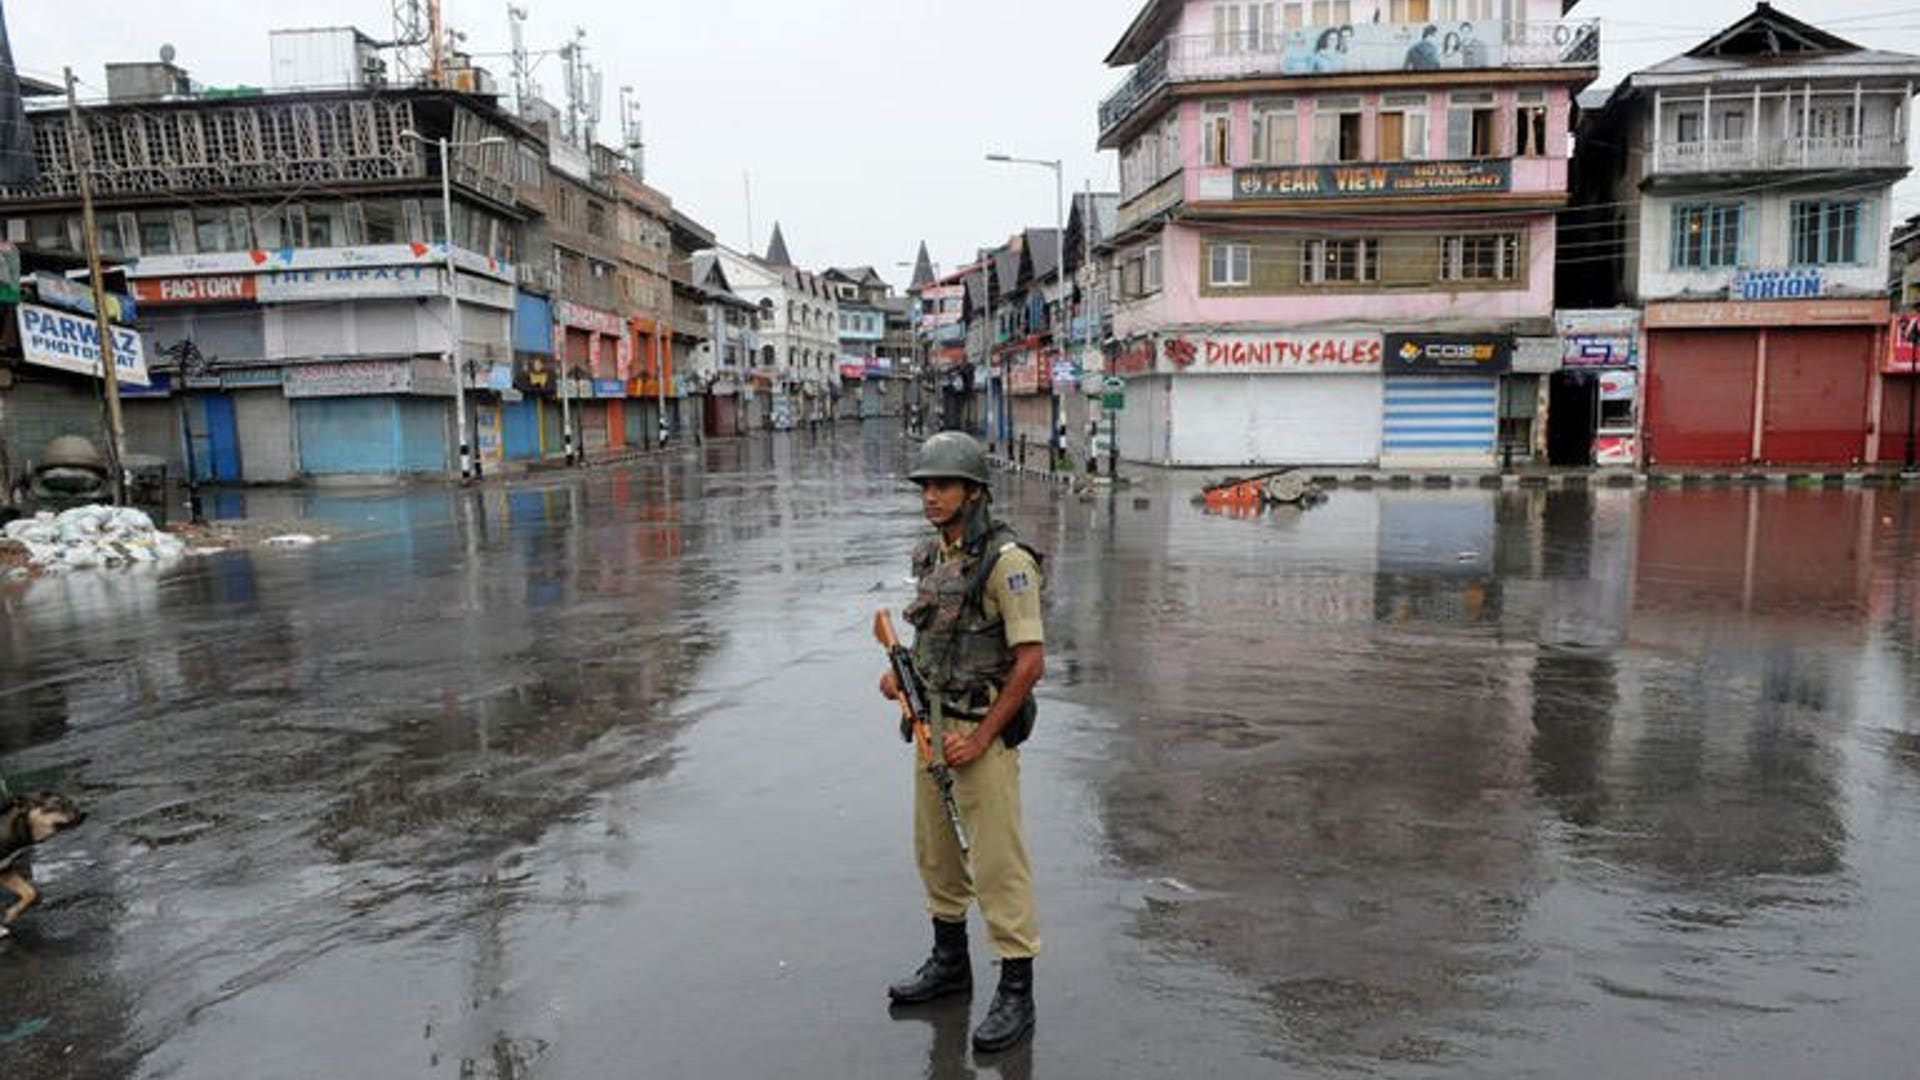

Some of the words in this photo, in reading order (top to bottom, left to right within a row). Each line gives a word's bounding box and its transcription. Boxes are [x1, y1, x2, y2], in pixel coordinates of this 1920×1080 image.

[1265, 171, 1318, 194] PEAK
[1333, 168, 1387, 192] VIEW
[160, 276, 244, 300] FACTORY
[1743, 276, 1820, 299] ORION
[31, 334, 136, 368] PHOTOAT
[1204, 338, 1302, 366] DIGNITY
[1307, 338, 1381, 364] SALES
